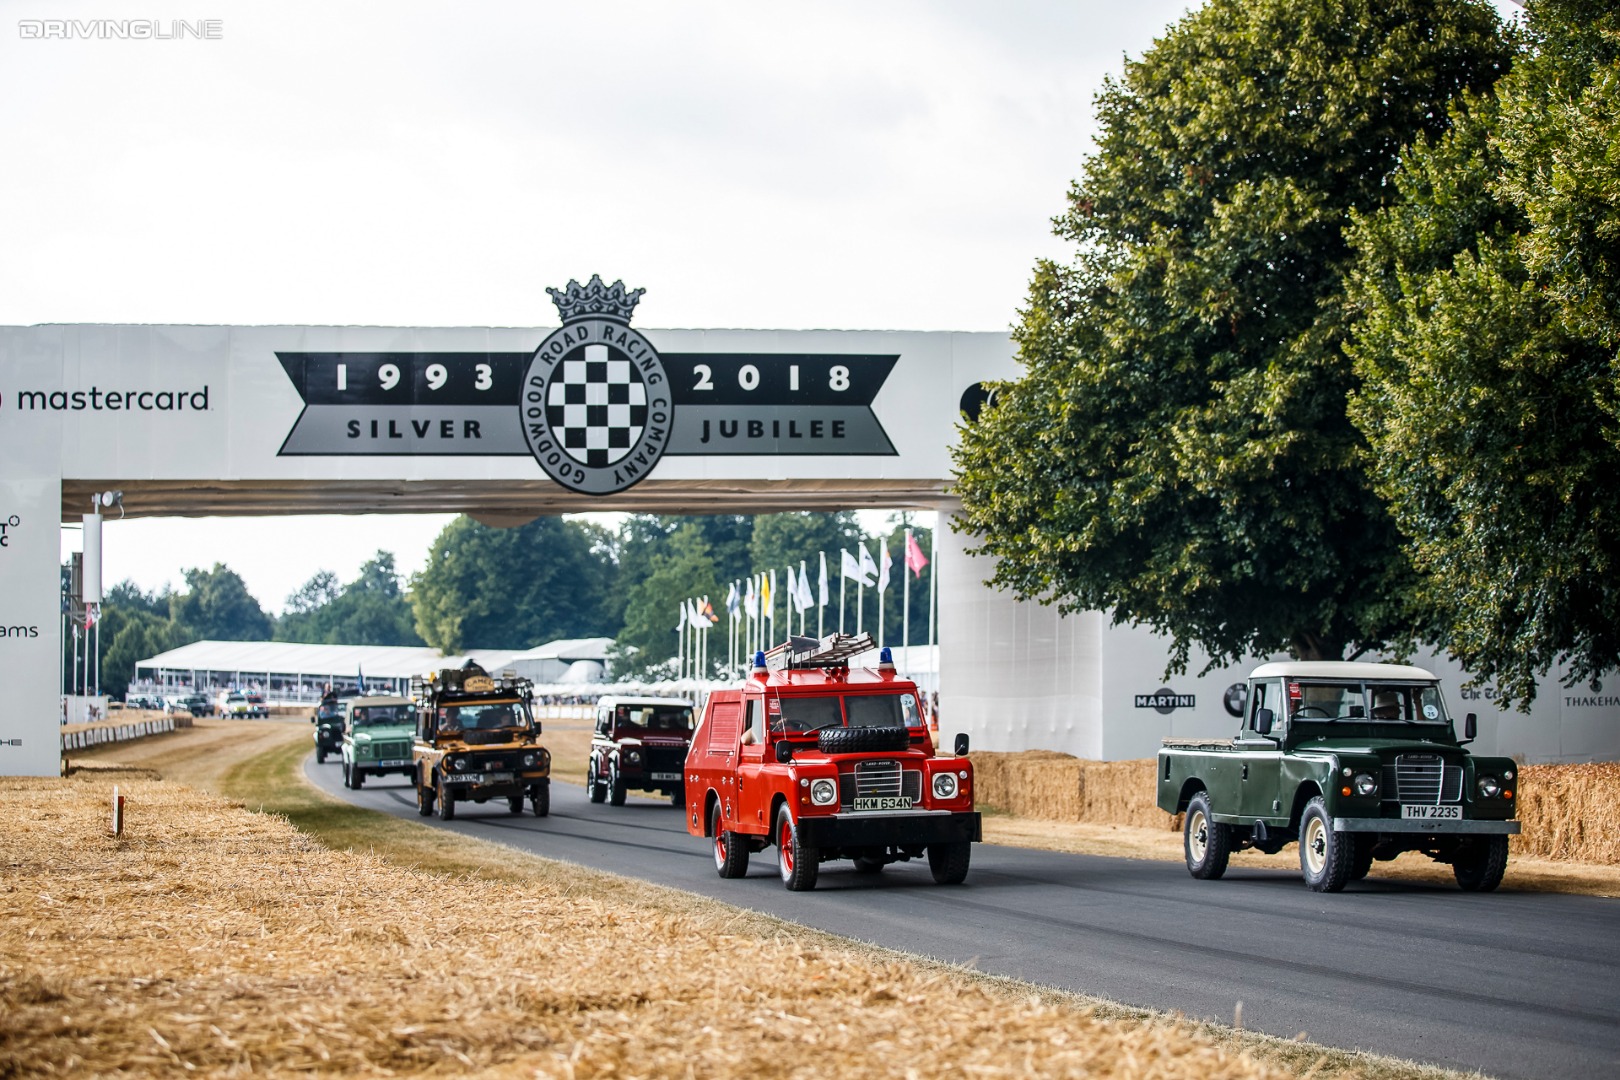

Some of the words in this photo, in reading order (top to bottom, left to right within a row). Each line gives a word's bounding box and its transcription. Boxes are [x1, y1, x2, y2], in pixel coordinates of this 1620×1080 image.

[540, 326, 588, 366] ROAD
[603, 325, 663, 386] RACING
[337, 363, 493, 391] 1993
[692, 364, 851, 392] 2018
[17, 385, 209, 411] mastercard
[347, 420, 482, 439] SILVER
[527, 376, 585, 485] GOODWOOD
[613, 398, 667, 486] COMPANY
[700, 420, 846, 444] JUBILEE
[1136, 696, 1194, 707] MARTINI
[855, 799, 878, 809] HKM
[880, 798, 911, 809] 634N
[1406, 806, 1427, 817] THV
[1430, 807, 1458, 818] 223S
